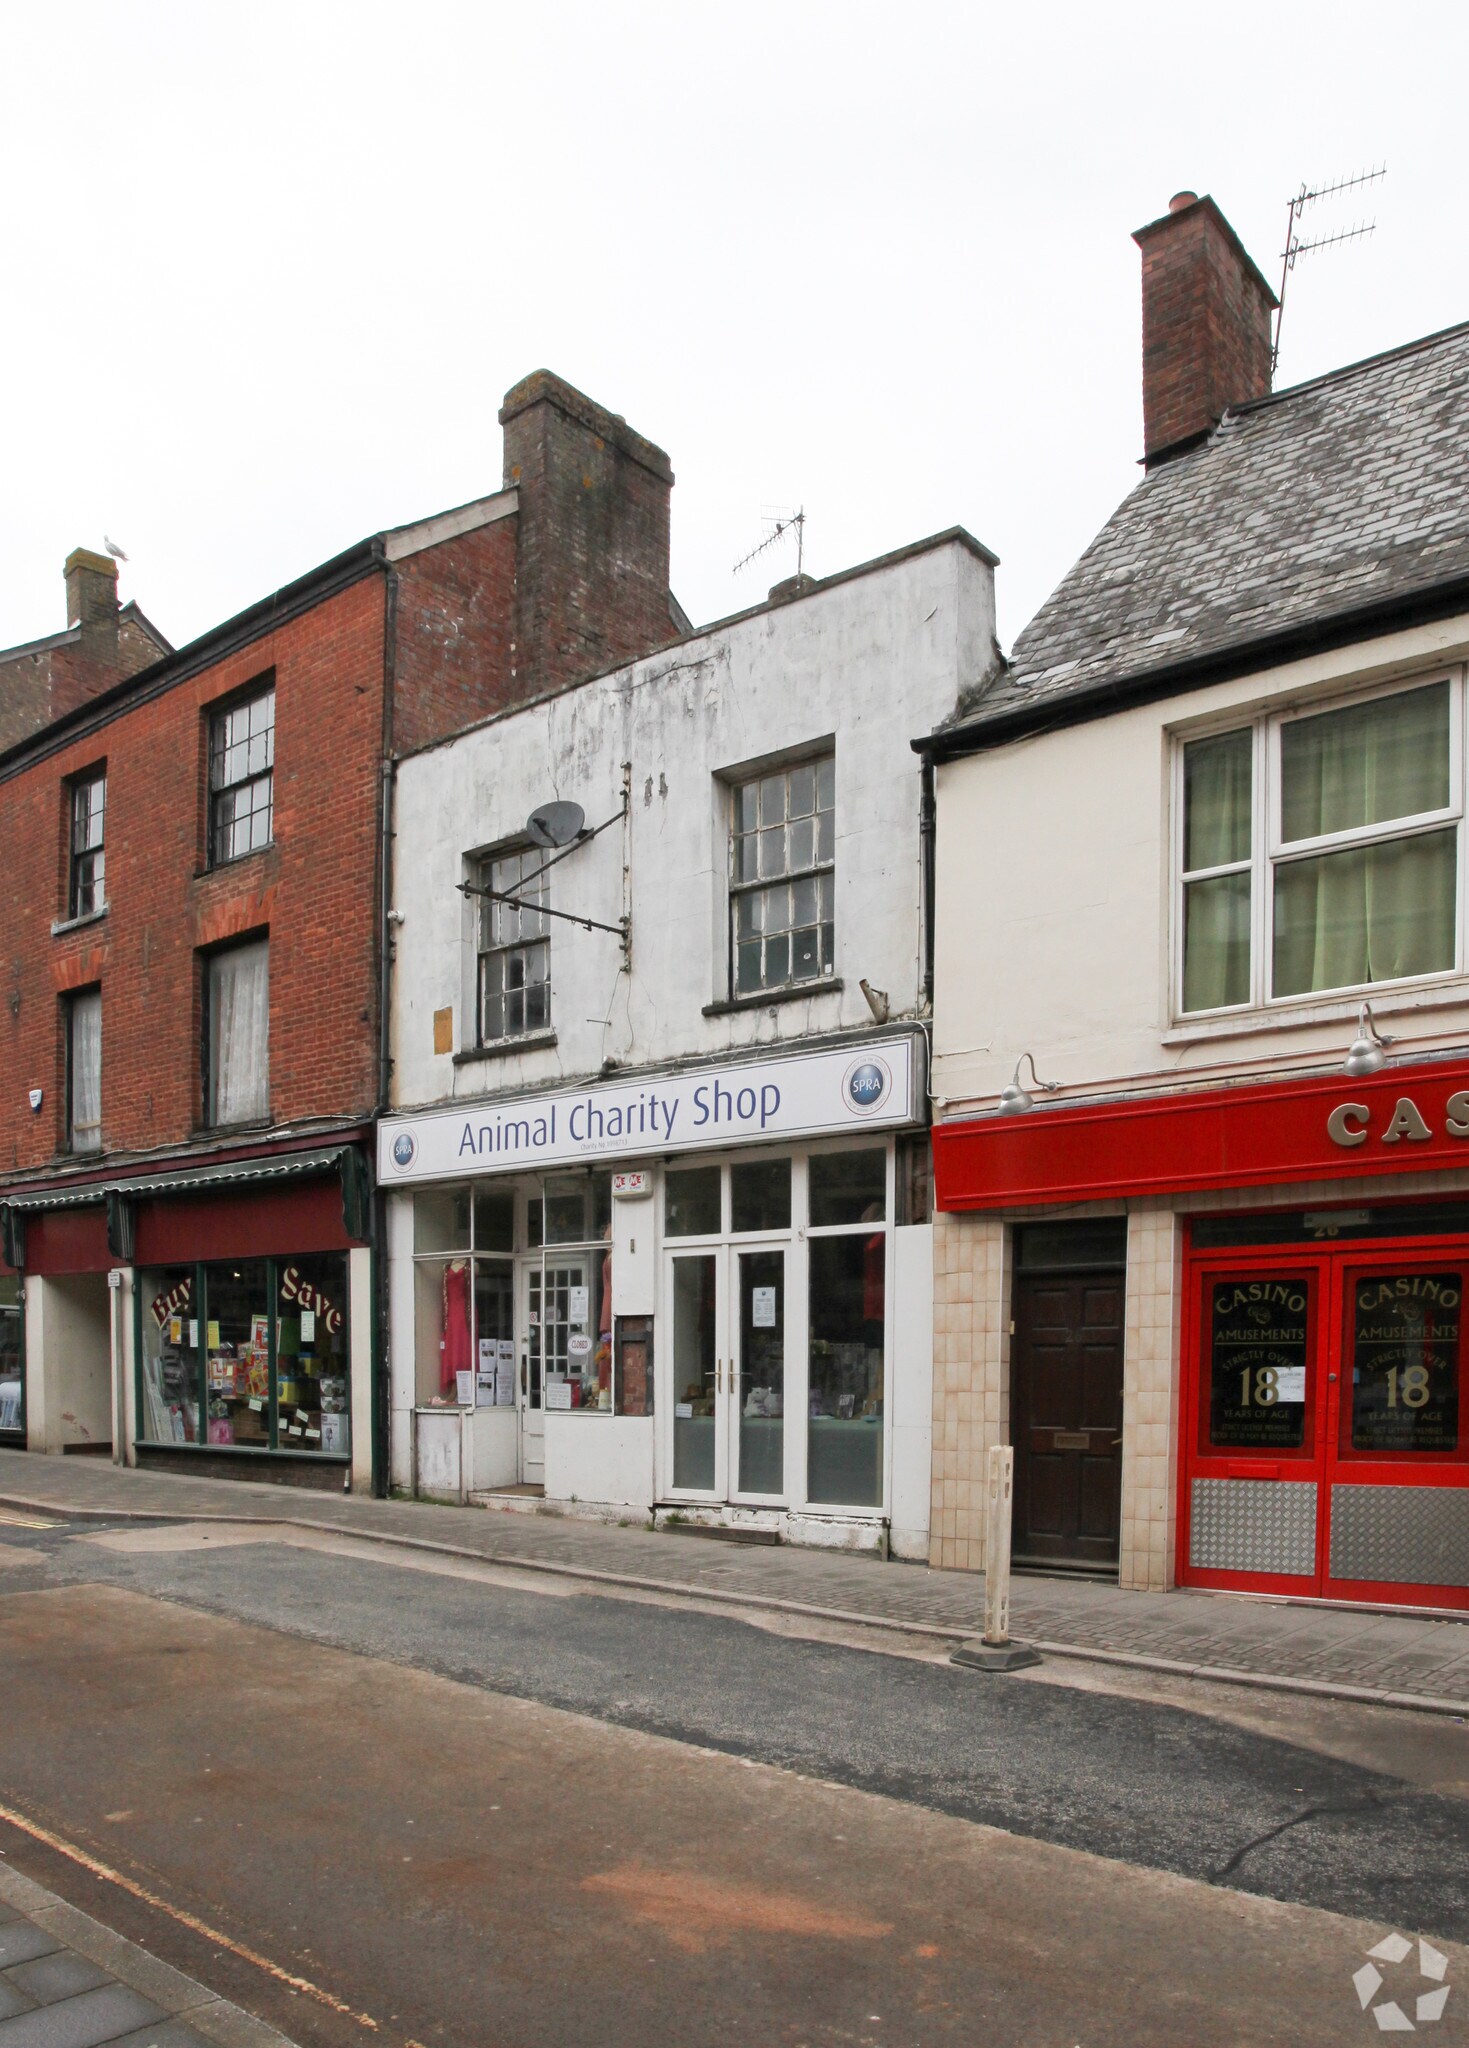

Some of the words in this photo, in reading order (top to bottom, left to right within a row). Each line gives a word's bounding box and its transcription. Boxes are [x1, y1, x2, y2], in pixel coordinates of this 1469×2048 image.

[852, 1078, 881, 1093] SPRA
[458, 1105, 556, 1157] Animal
[569, 1093, 680, 1141] Charity
[693, 1079, 781, 1129] Shop
[395, 1144, 413, 1156] SPRA
[150, 1277, 192, 1331] Buy
[280, 1267, 342, 1334] Save
[1215, 1283, 1306, 1314] CASINO
[1359, 1278, 1459, 1310] CASINO
[1215, 1328, 1305, 1341] AMUSEMENTS
[1358, 1325, 1459, 1339] AMUSEMENTS
[571, 1340, 589, 1349] CLOSED
[1222, 1350, 1265, 1372] STRICTLY
[1267, 1352, 1295, 1371] OVER
[1366, 1348, 1412, 1371] STRICTLY
[1417, 1350, 1447, 1370] OVER
[1240, 1366, 1279, 1407] 18
[1384, 1365, 1430, 1408] 18
[1223, 1409, 1251, 1418] YEARS
[1254, 1409, 1267, 1418] OF
[1270, 1410, 1290, 1419] AGE
[1368, 1411, 1399, 1421] YEARS
[1402, 1411, 1417, 1421] OF
[1420, 1411, 1443, 1421] AGE
